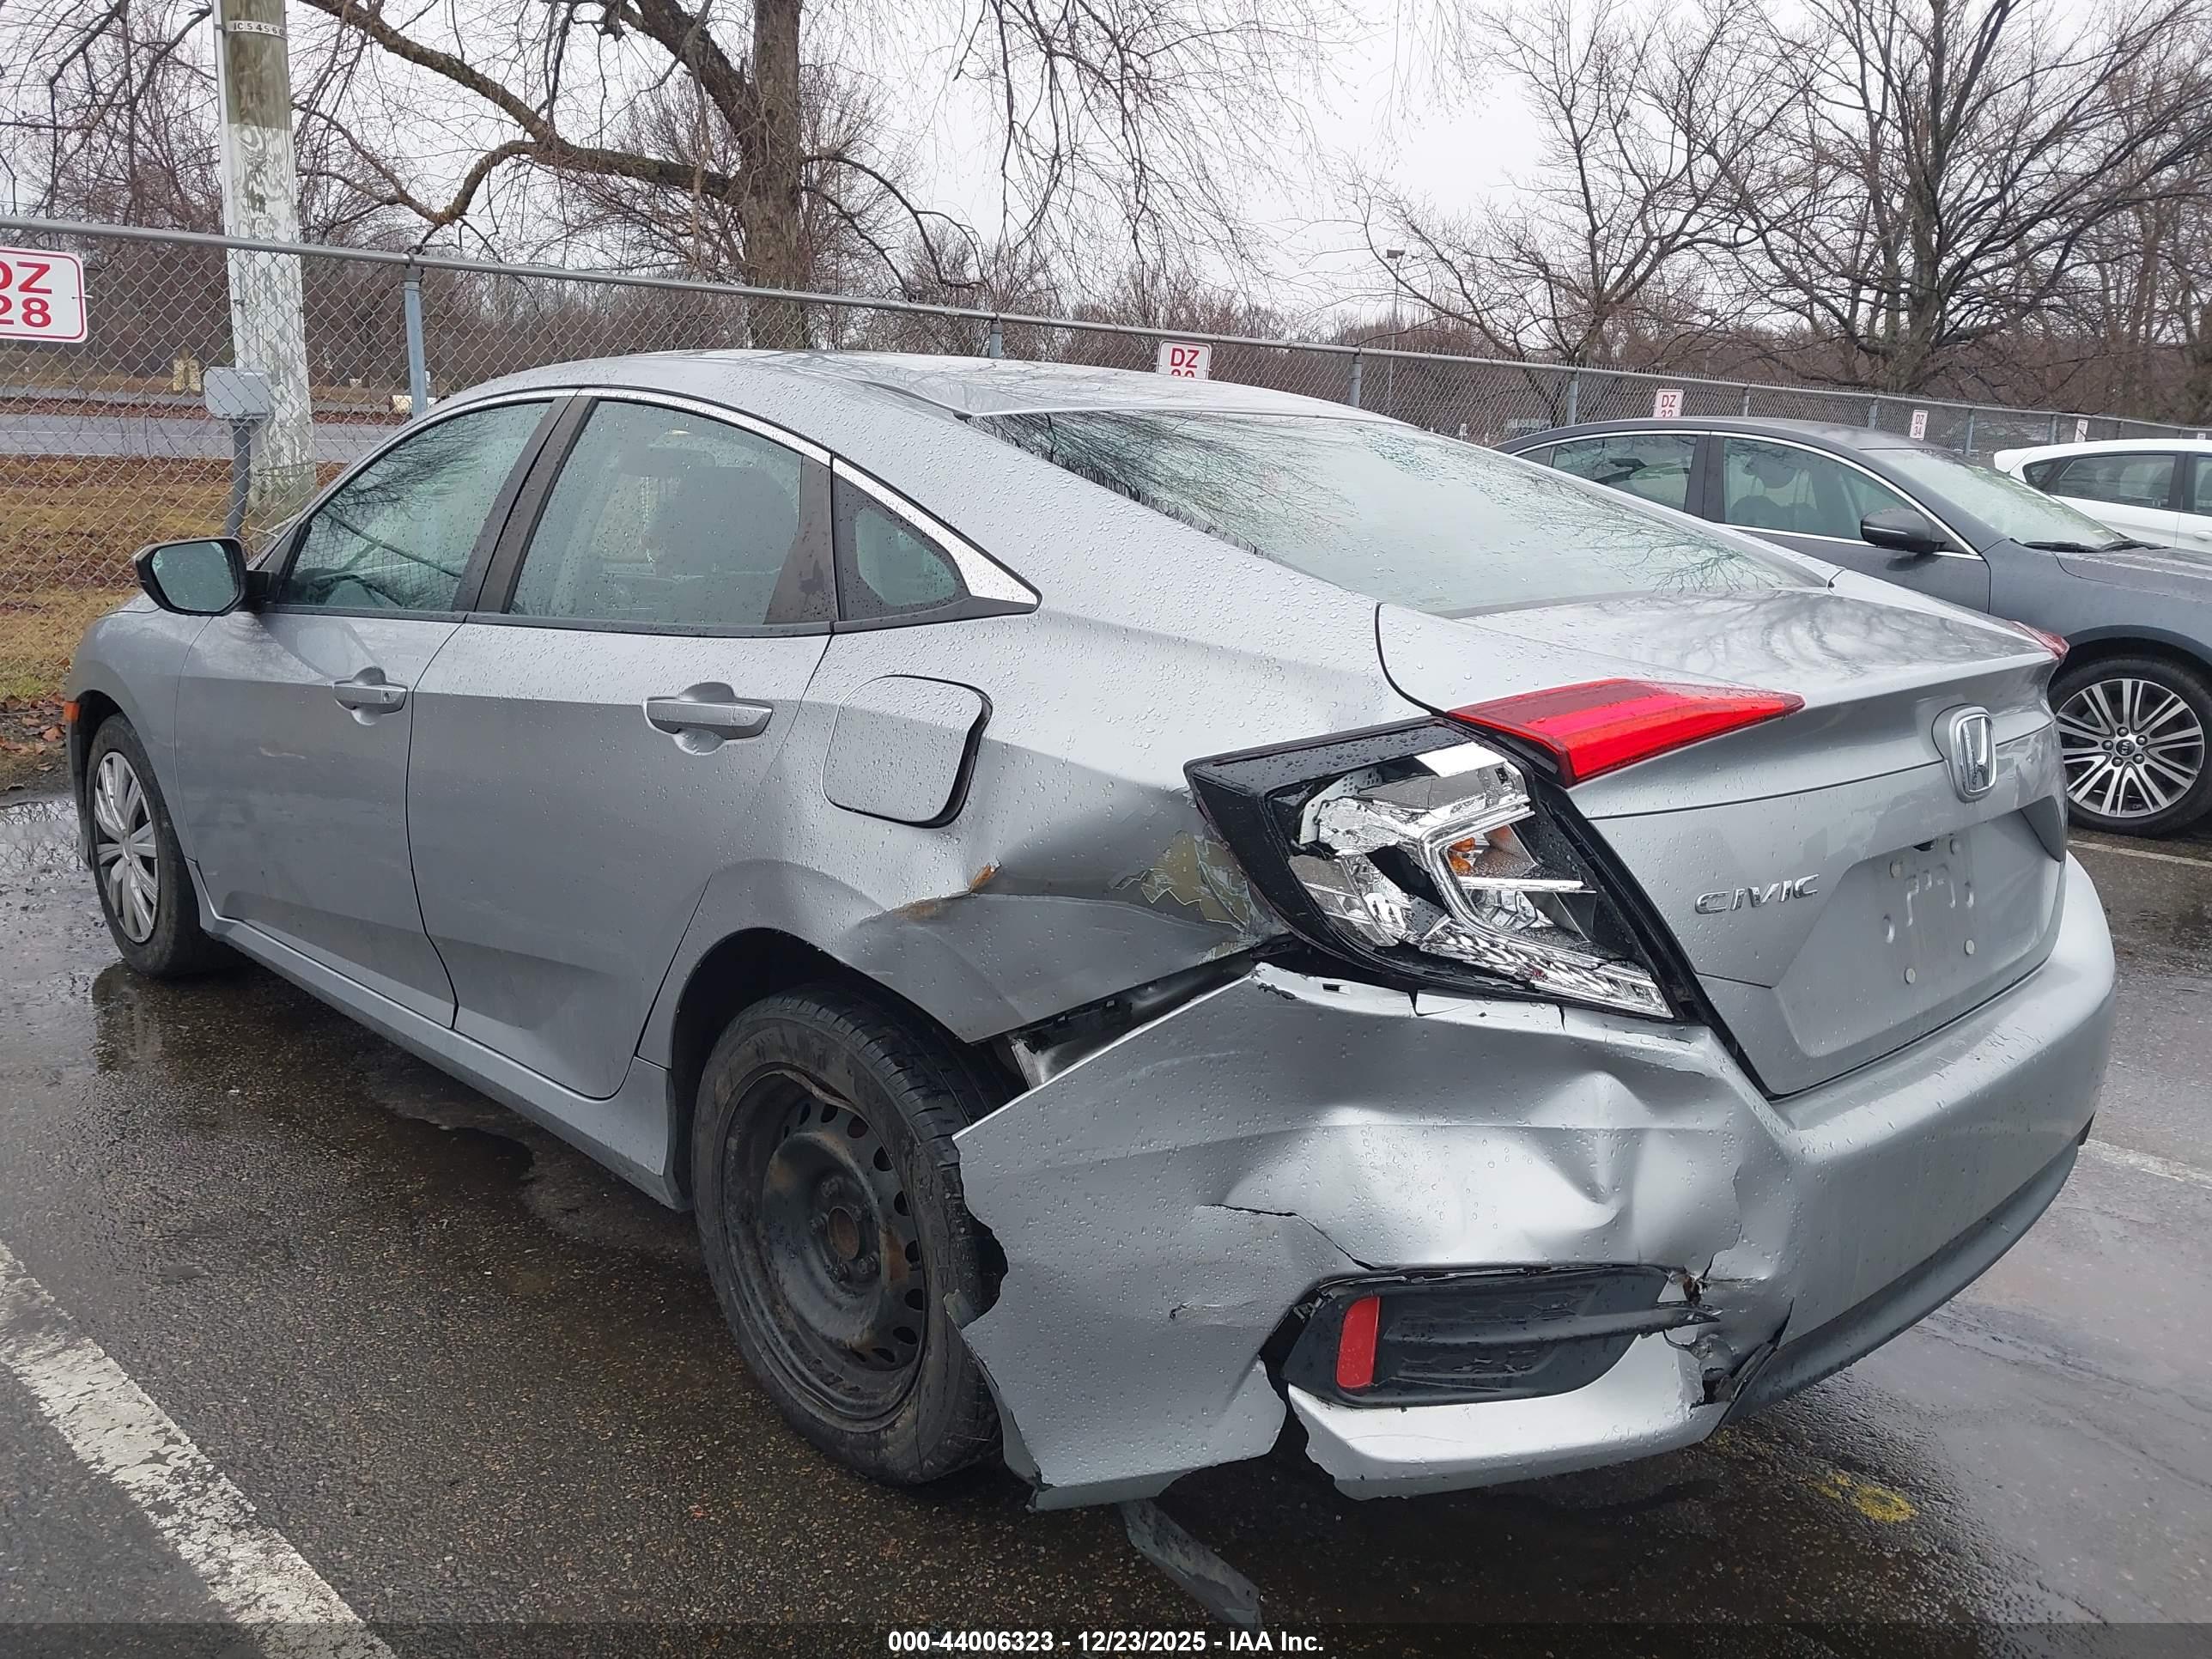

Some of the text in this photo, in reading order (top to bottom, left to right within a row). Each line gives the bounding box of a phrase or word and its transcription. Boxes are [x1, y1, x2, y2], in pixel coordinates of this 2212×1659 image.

[1170, 347, 1200, 368] DZ
[1662, 395, 1676, 407] DZ
[2121, 741, 2130, 755] KIA
[1694, 873, 1820, 915] CIVIC
